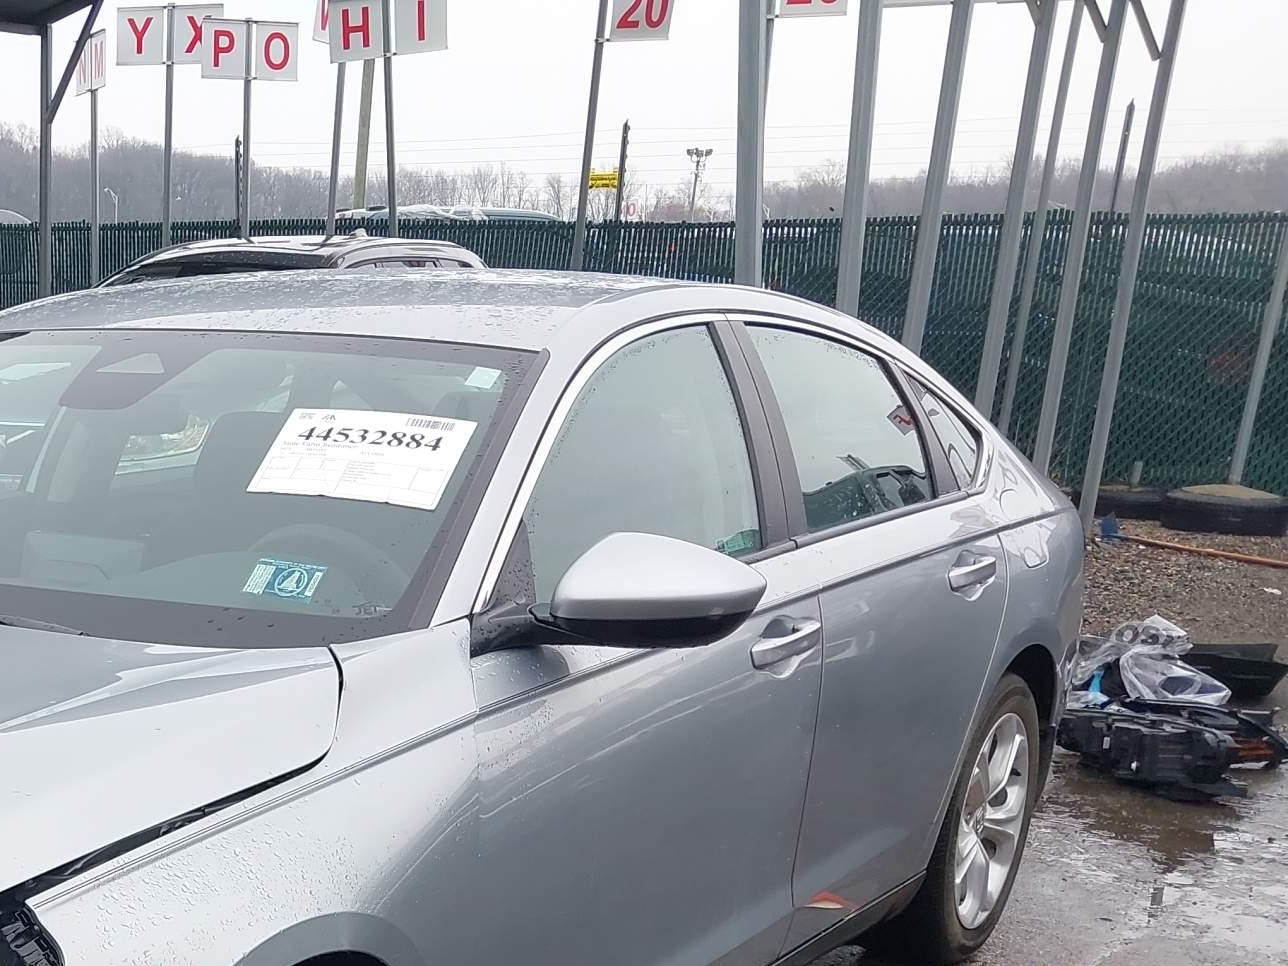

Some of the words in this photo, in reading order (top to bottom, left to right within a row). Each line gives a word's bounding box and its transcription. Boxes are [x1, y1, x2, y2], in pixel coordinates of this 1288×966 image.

[127, 17, 154, 54] Y
[342, 6, 370, 50] H
[213, 30, 235, 67] P
[298, 425, 443, 452] 44532884
